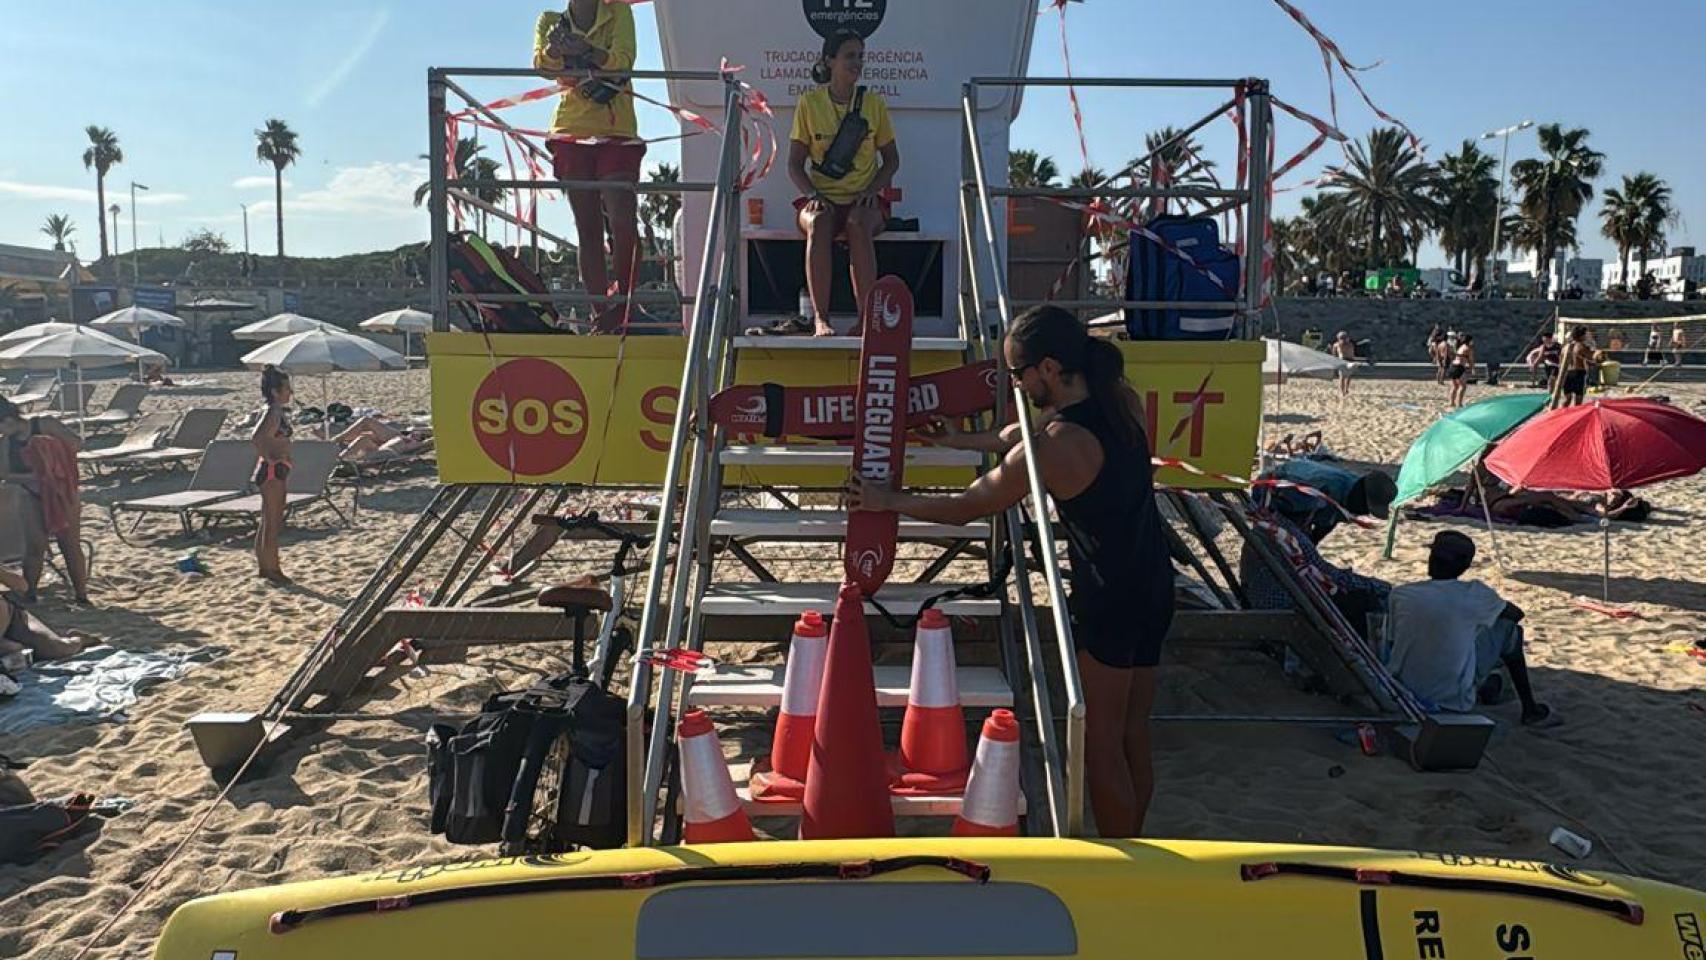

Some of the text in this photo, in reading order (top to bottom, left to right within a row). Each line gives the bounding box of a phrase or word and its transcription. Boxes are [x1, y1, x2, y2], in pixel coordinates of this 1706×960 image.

[761, 68, 814, 79] LLAMAD
[478, 398, 584, 435] SOS
[803, 383, 939, 423] LIFERD
[861, 355, 897, 481] LIFEGUAR
